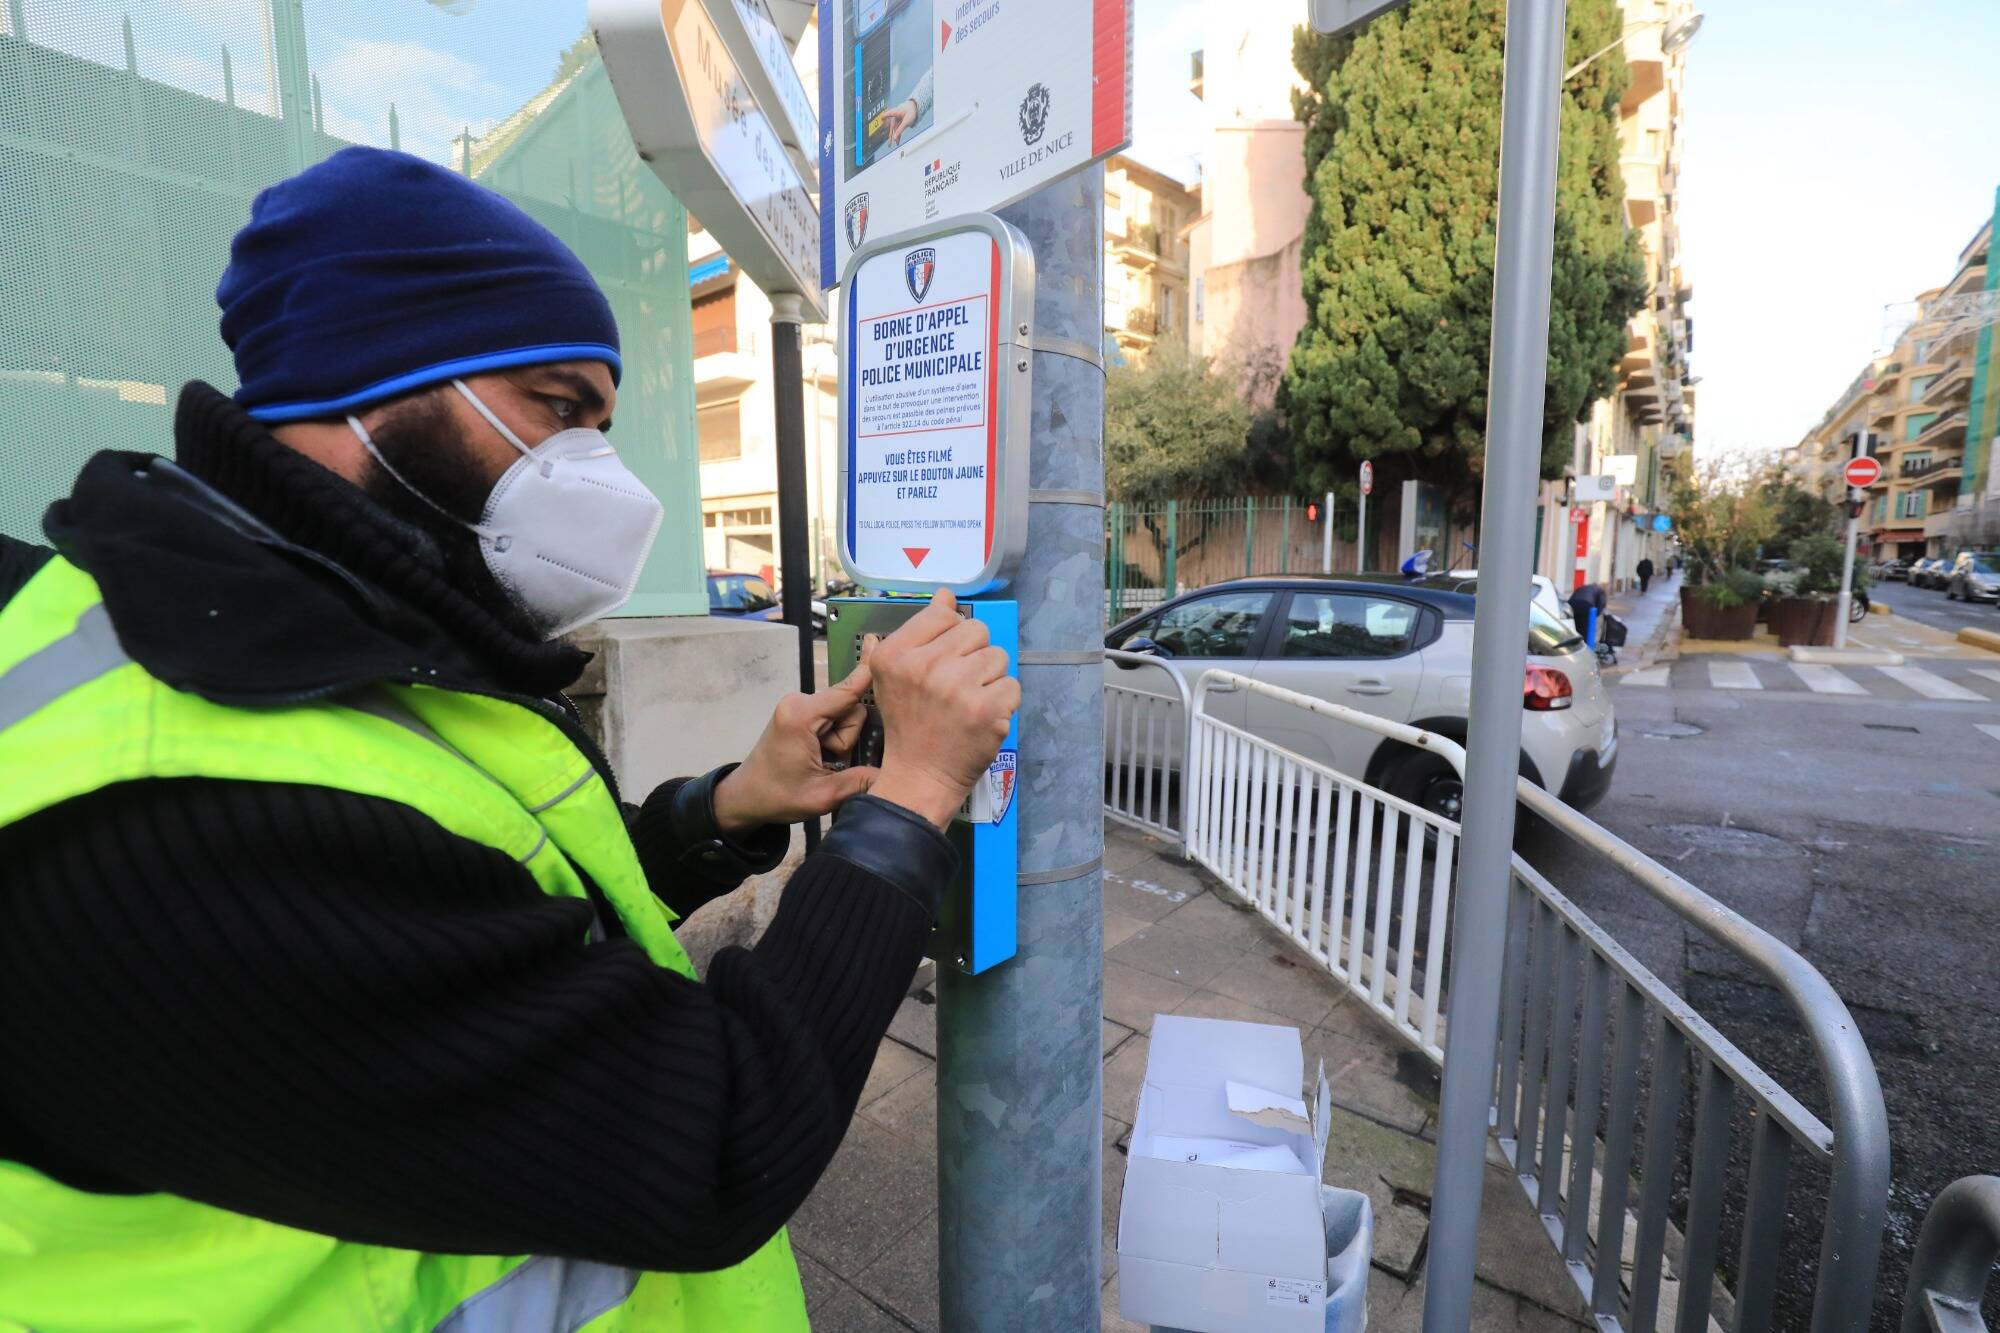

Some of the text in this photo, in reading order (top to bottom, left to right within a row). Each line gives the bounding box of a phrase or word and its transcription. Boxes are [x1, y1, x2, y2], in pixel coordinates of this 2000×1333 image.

[955, 0, 984, 22] Interve
[955, 1, 1000, 44] des secours
[698, 25, 747, 137] Musée
[756, 131, 774, 181] des
[999, 131, 1073, 181] VILLE DE NICE
[924, 161, 961, 189] RÉPUBLIQUE
[924, 173, 959, 199] FRANÇAISE
[846, 195, 867, 213] POLICE
[767, 192, 794, 255] Jules
[907, 250, 934, 263] POLICE
[874, 305, 968, 341] BORNE D'APPEL
[885, 332, 955, 361] D'URGENCE
[862, 351, 982, 387] POLICE MUNICIPALE
[863, 392, 980, 413] dans le but de provoquer une intervention
[865, 381, 977, 403] L'utilisation abusive d'un système d'alerte
[861, 403, 981, 423] des secours est passible des peines prévues
[922, 418, 930, 427] du
[930, 417, 945, 426] code
[885, 446, 953, 466] VOUS ÊTES FILMÉ
[858, 465, 984, 484] APPUYEZ SUR LE BOUTON JAUNE
[897, 486, 938, 499] ET PARLEZ
[864, 520, 873, 529] CALL
[874, 520, 885, 529] LOCAL
[900, 520, 913, 529] PRESS
[914, 520, 922, 529] THE
[922, 520, 939, 529] YELLOW
[940, 520, 956, 529] BUTTON
[957, 520, 966, 529] AND
[967, 520, 981, 529] SPEAK
